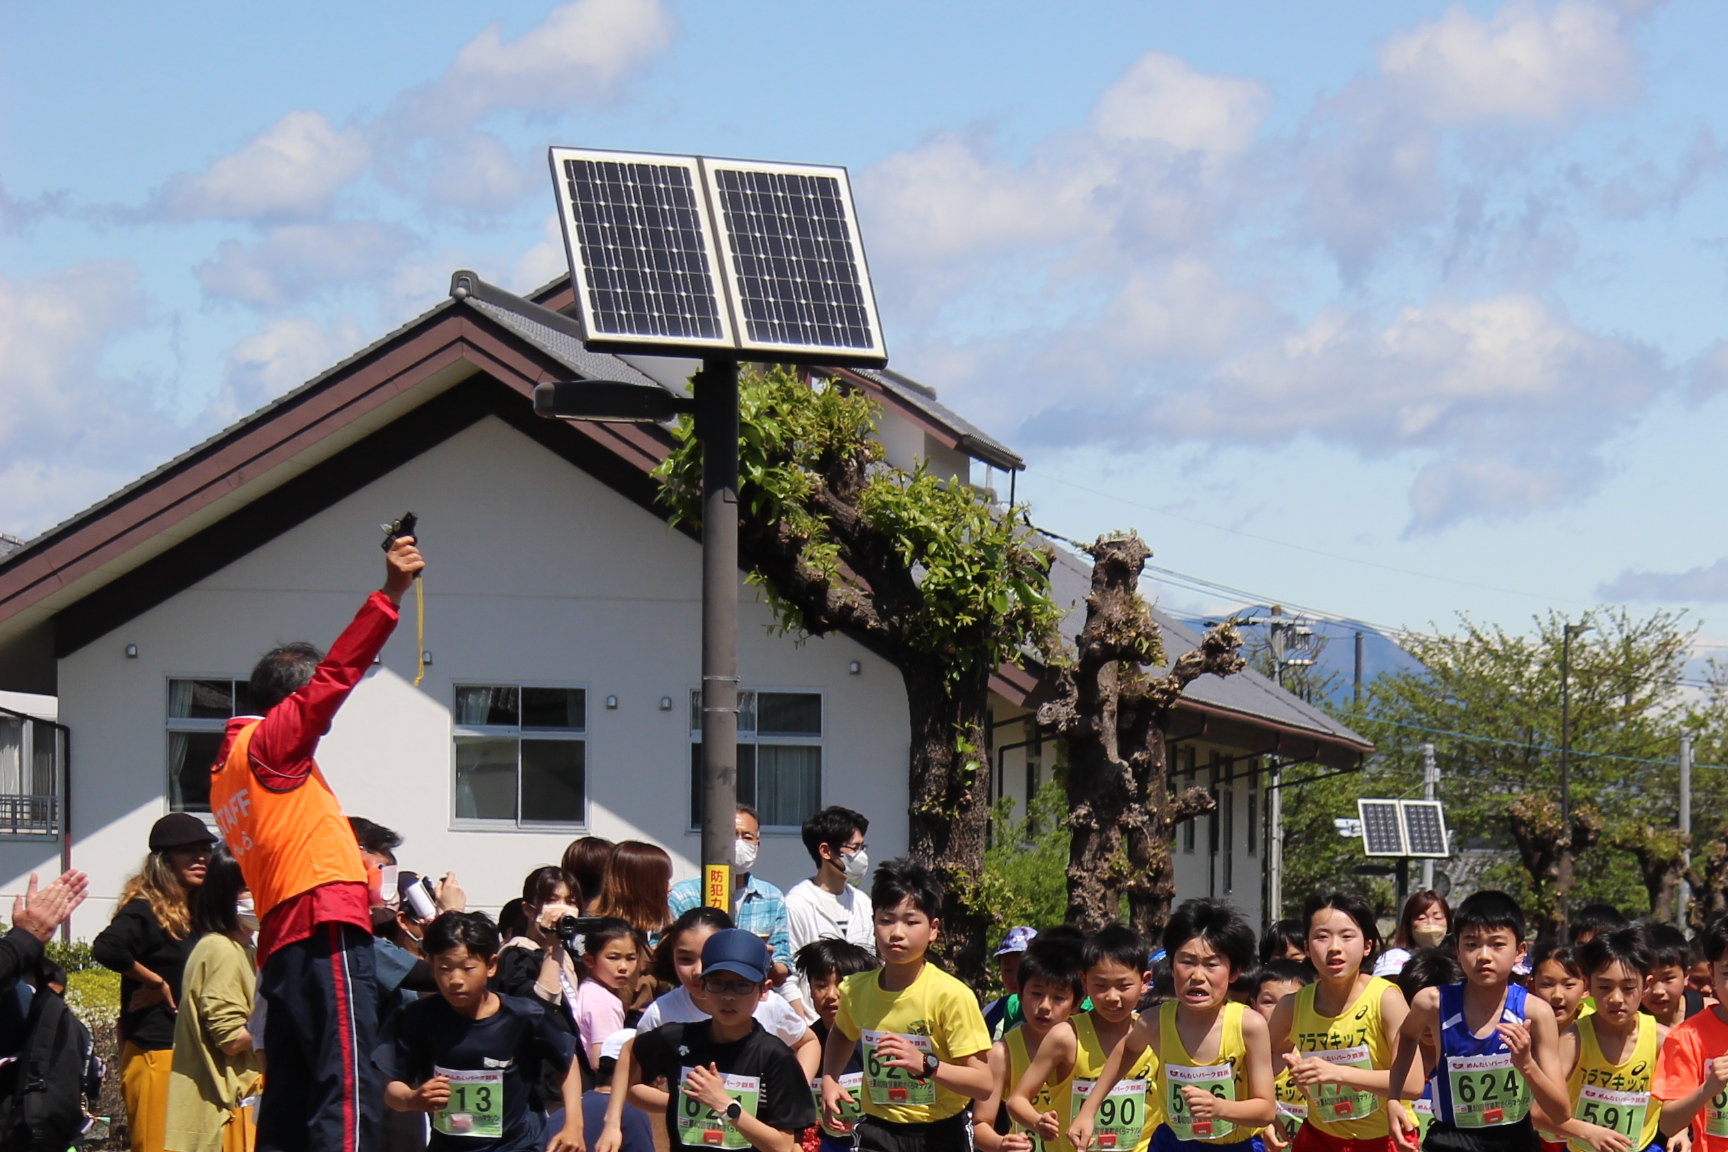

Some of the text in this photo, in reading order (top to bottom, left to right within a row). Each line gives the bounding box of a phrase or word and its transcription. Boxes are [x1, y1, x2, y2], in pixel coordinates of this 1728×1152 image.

[456, 1087, 492, 1112] 13
[1458, 1070, 1519, 1103] 624
[1080, 1098, 1135, 1126] 90
[1582, 1103, 1634, 1135] 591
